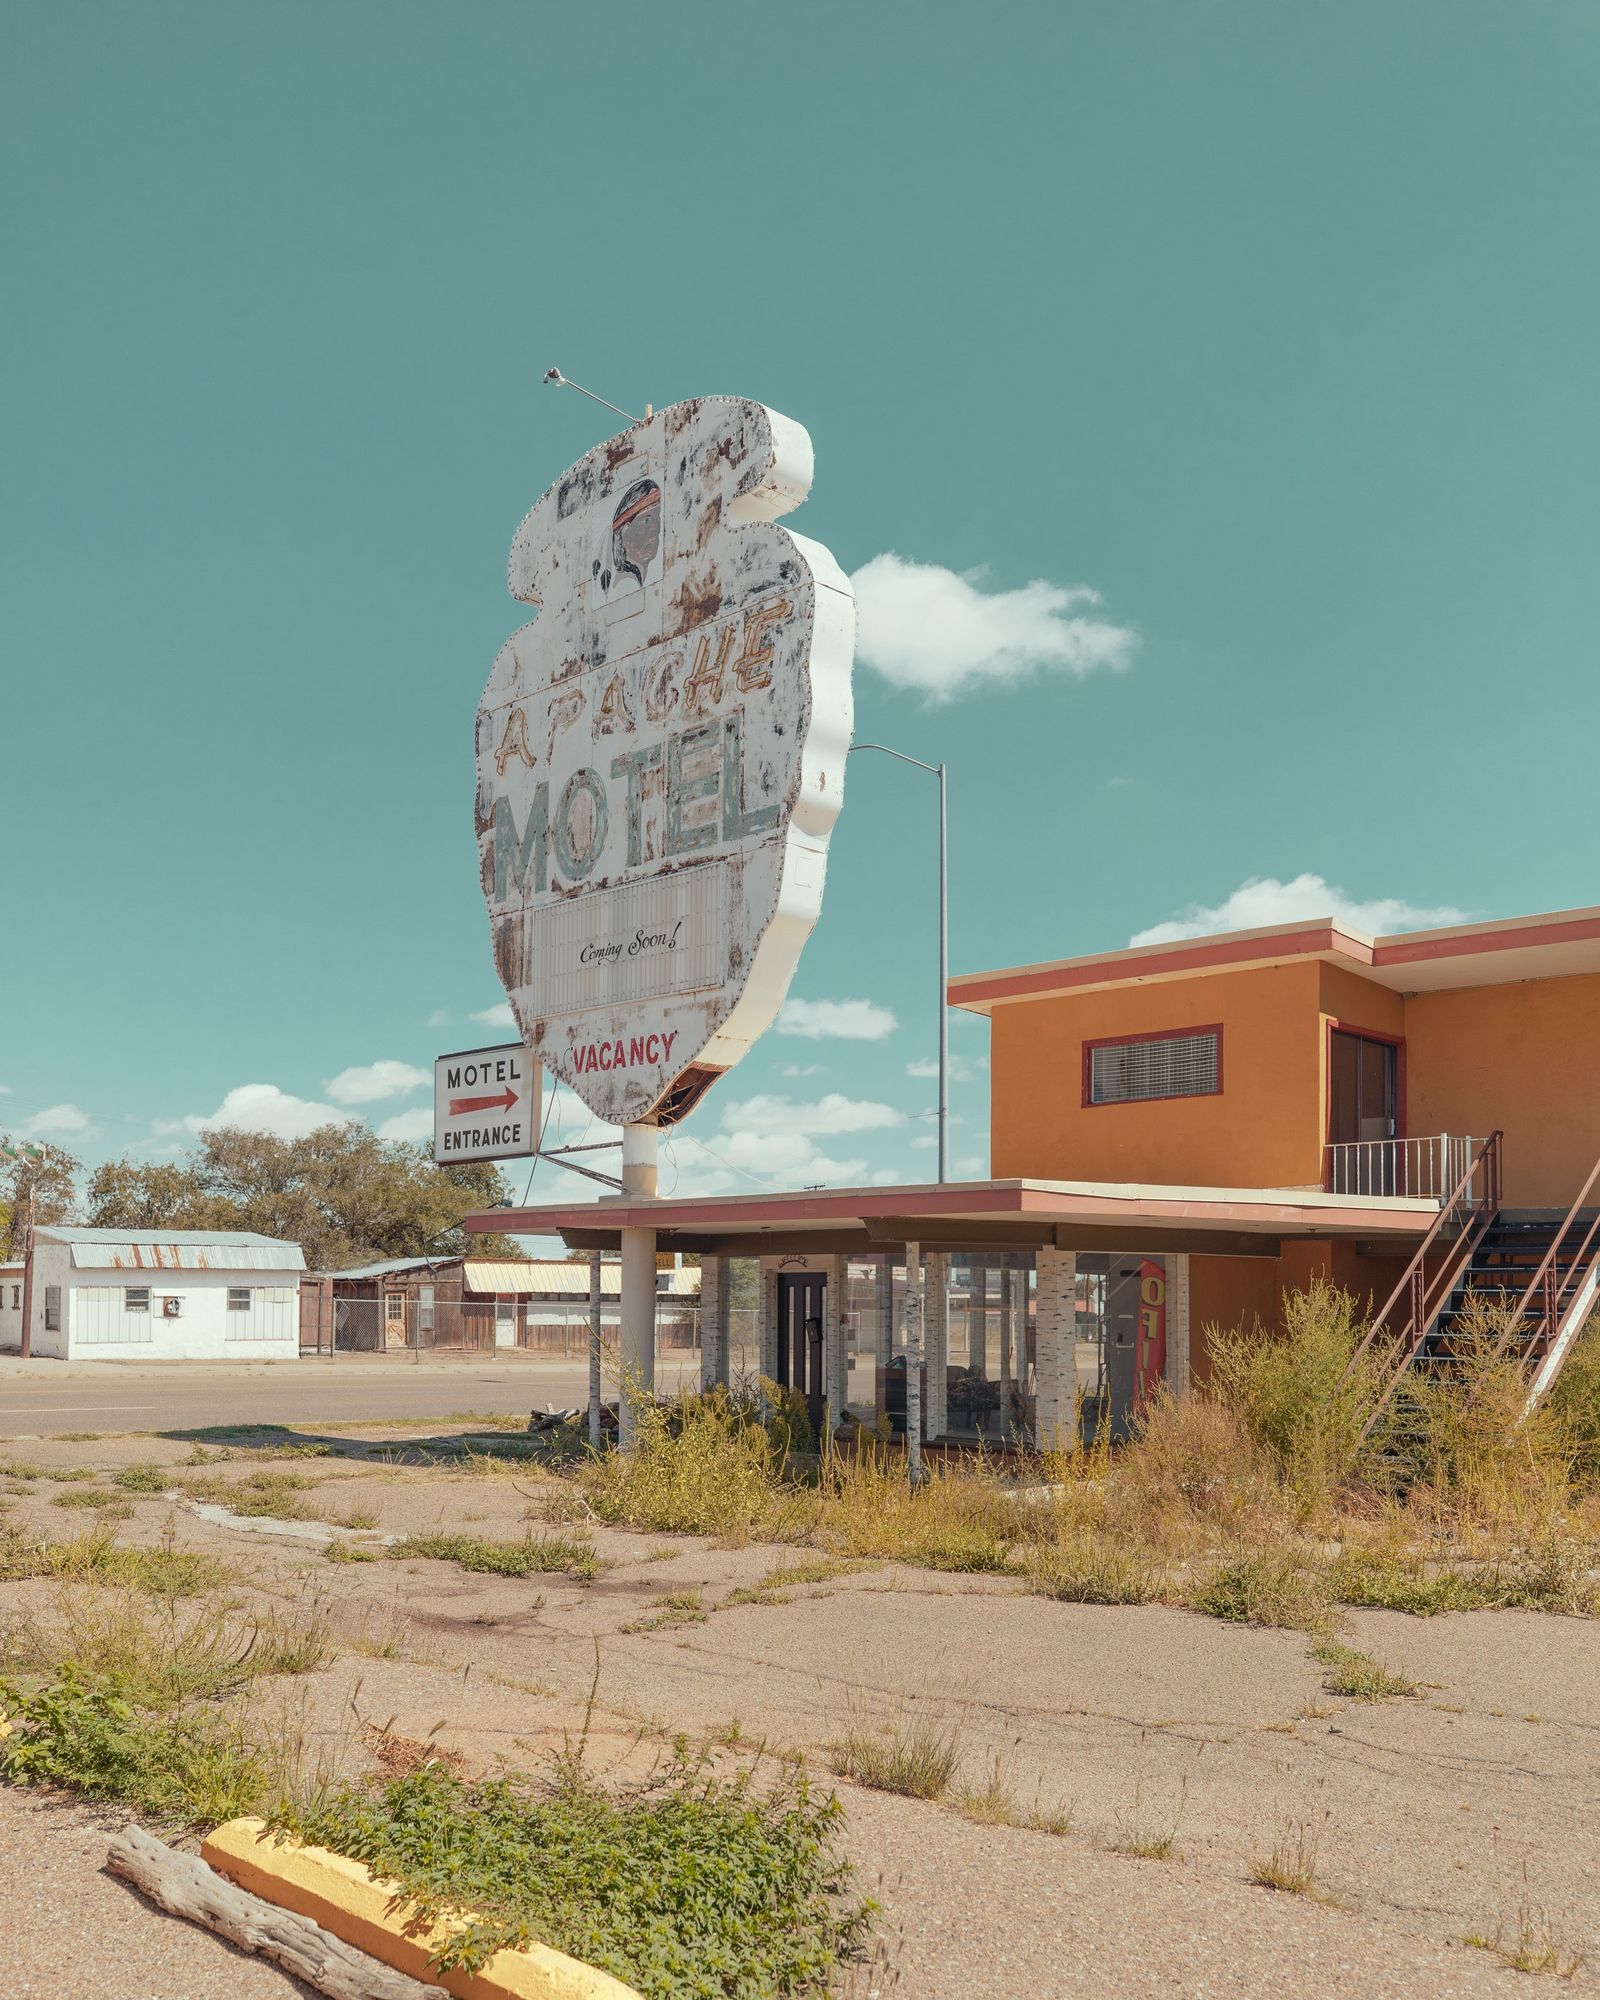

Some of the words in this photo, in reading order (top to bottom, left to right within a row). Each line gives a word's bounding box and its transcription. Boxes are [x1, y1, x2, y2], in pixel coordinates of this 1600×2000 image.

[494, 600, 793, 777] APACHE
[494, 715, 781, 904] MOTEL
[580, 942, 623, 965] Coming
[628, 921, 682, 955] Soon!
[447, 1059, 520, 1089] MOTEL
[573, 1032, 678, 1074] VACANCY
[444, 1124, 521, 1150] ENTRANCE
